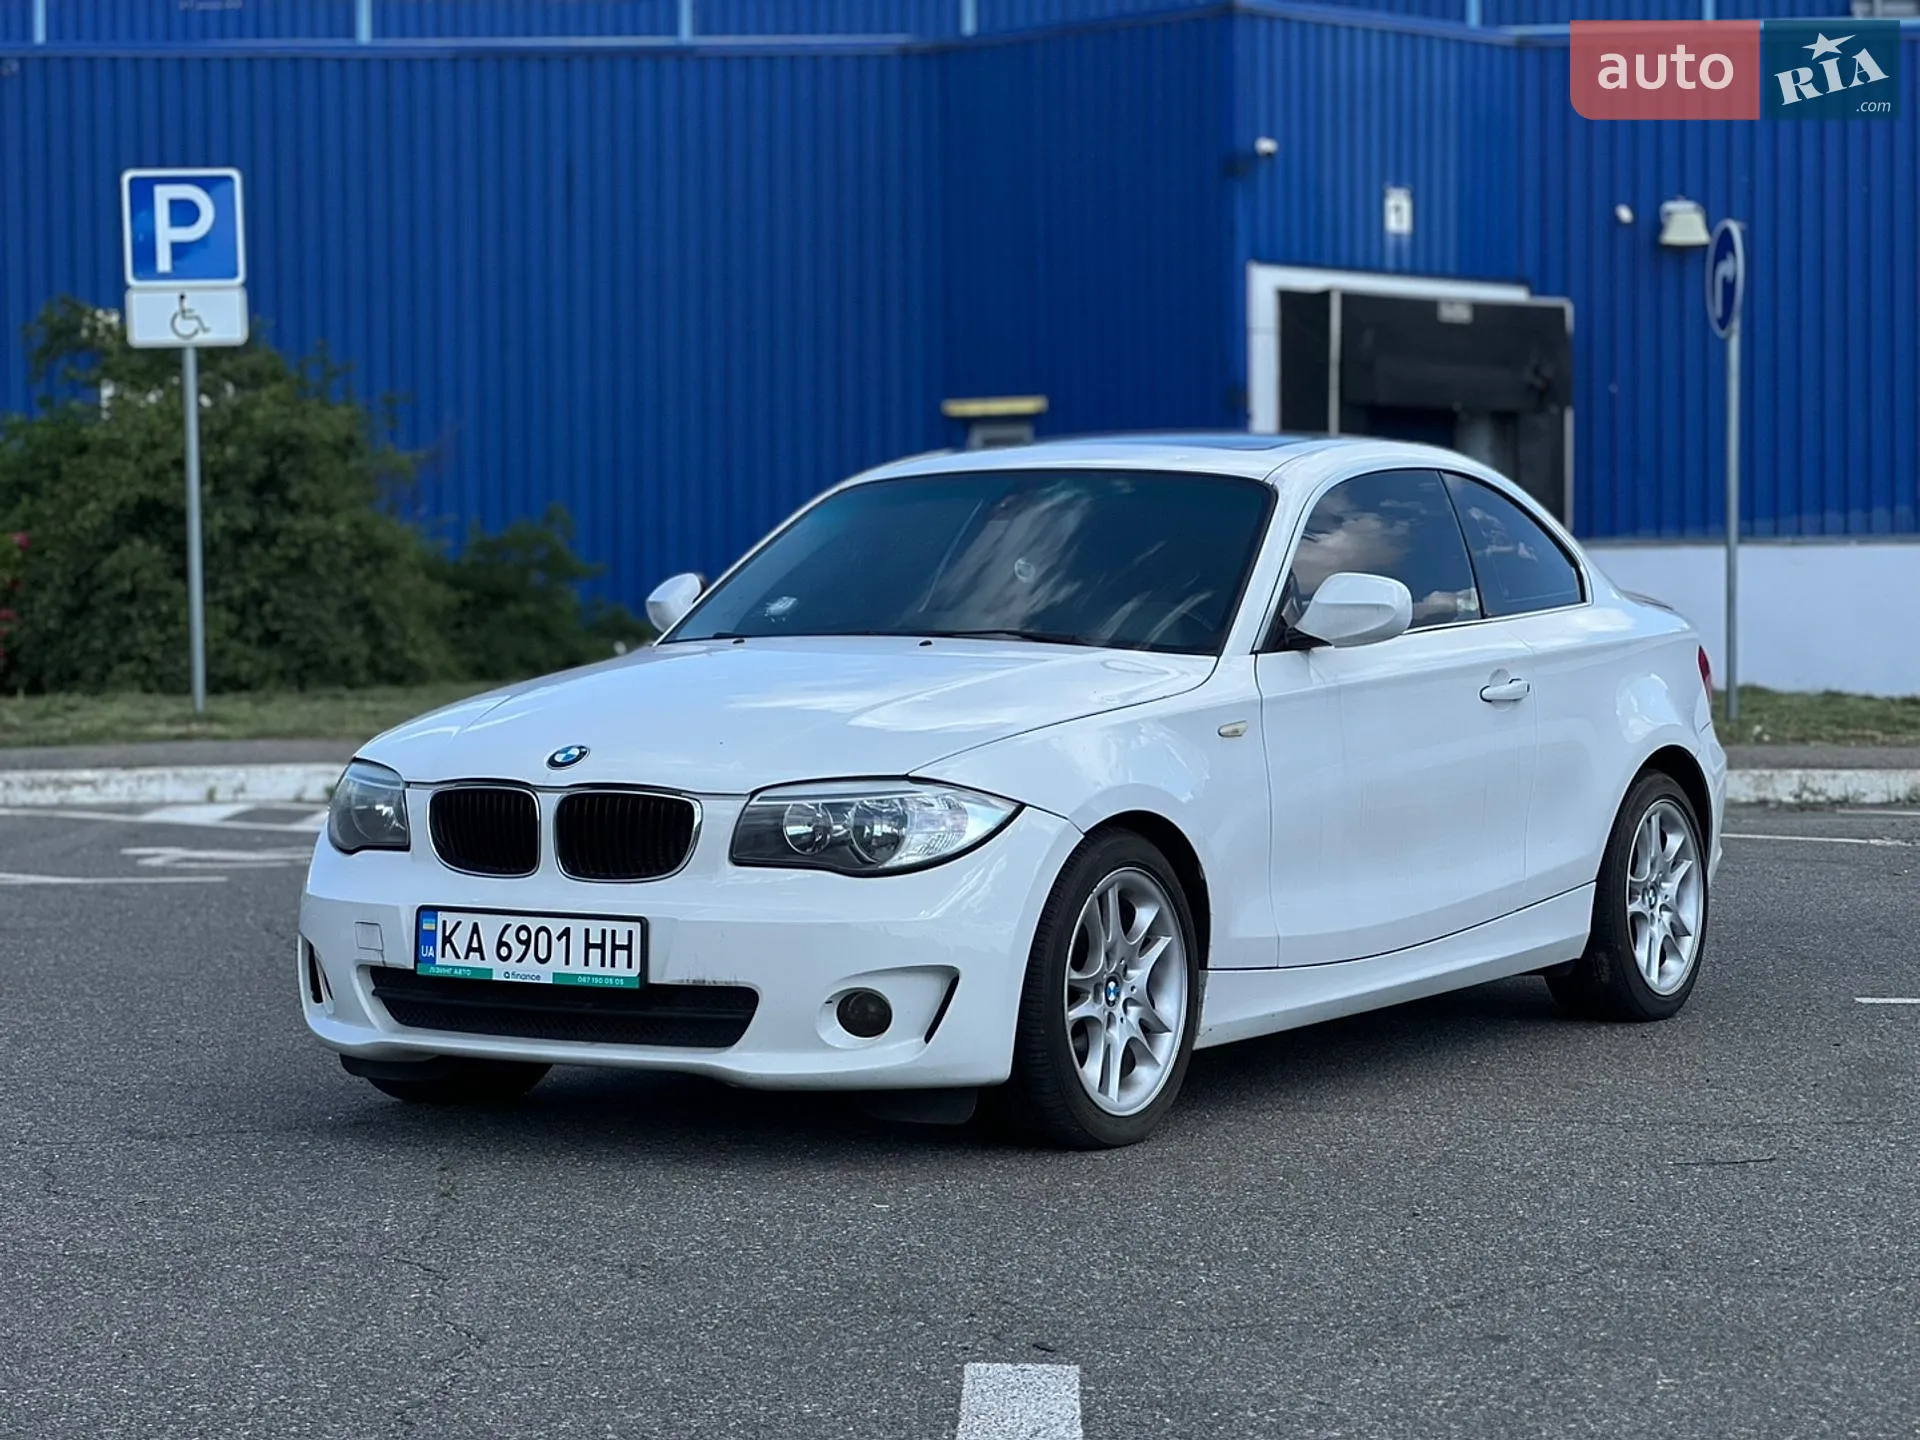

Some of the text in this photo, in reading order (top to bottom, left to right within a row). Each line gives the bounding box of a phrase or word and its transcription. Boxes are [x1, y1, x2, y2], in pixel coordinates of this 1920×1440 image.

[153, 183, 216, 274] P
[421, 945, 435, 958] UA
[440, 919, 633, 969] KA 6901 HH
[511, 971, 541, 981] finance
